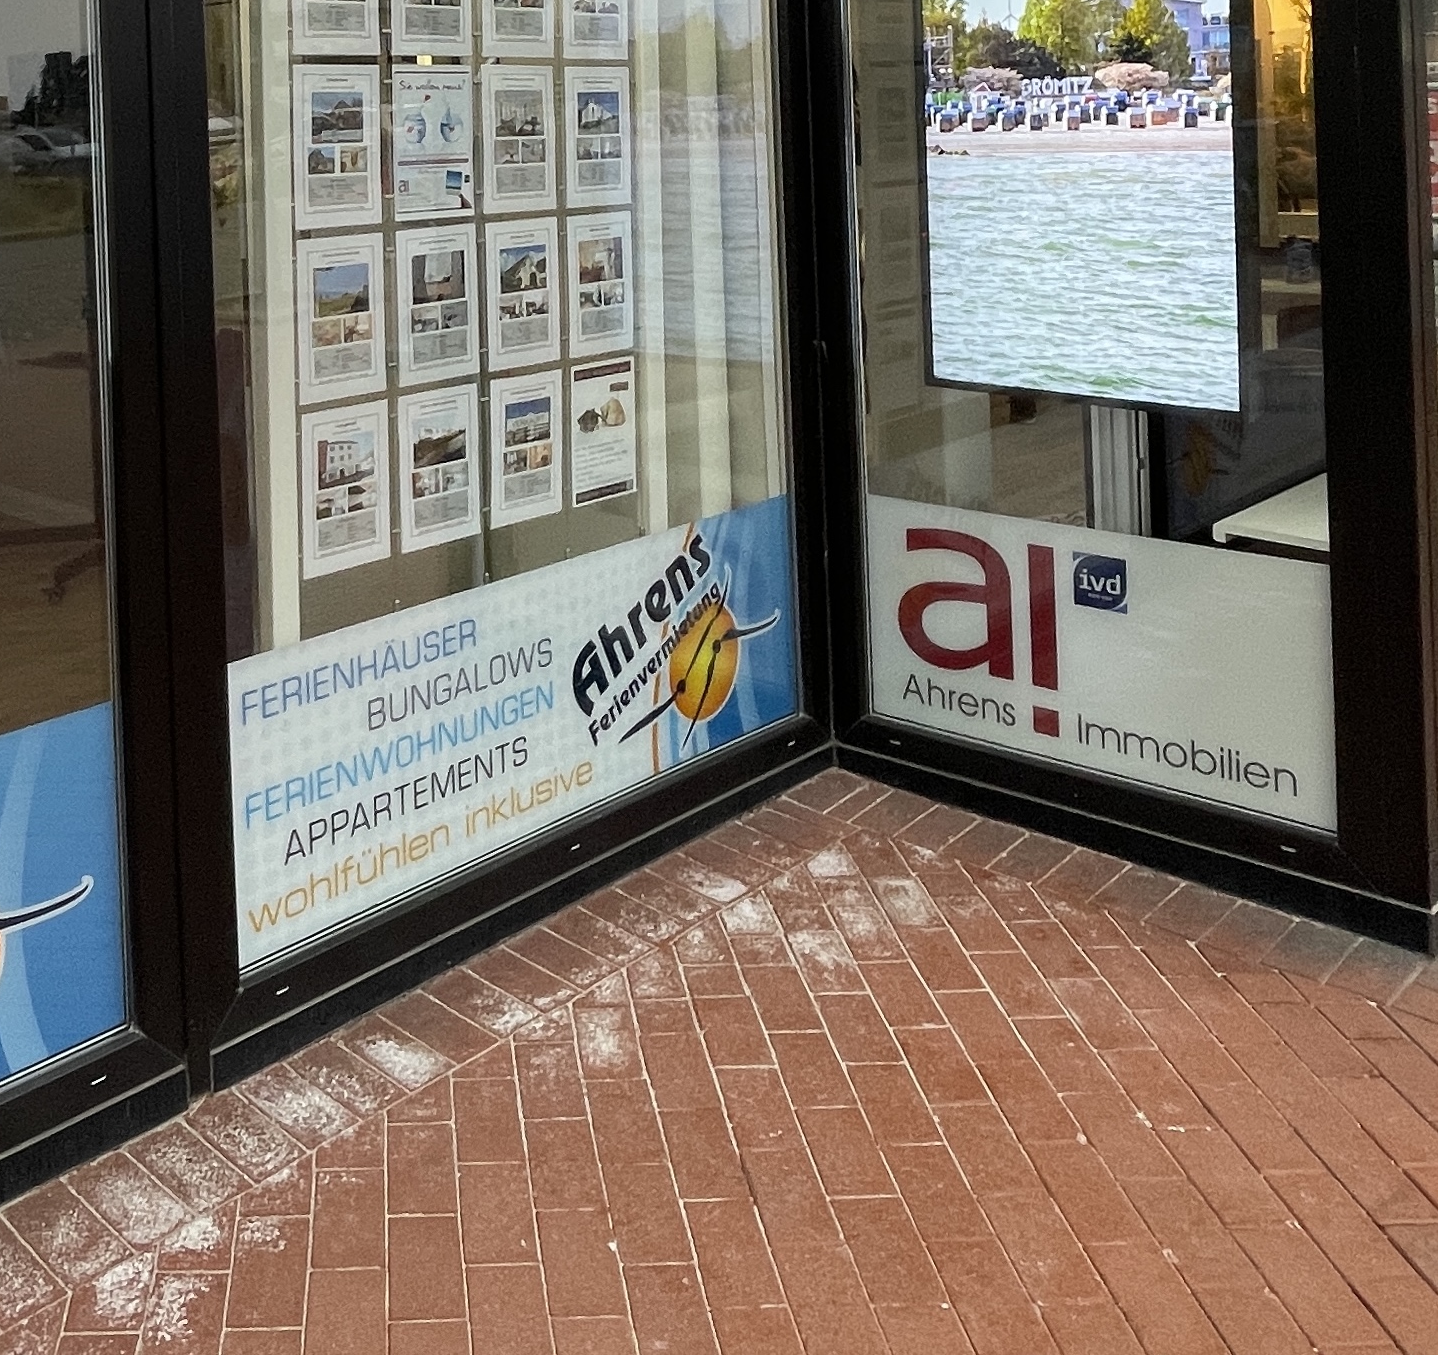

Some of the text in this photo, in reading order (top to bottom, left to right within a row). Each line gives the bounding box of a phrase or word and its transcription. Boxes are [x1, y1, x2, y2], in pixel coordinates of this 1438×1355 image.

[1022, 75, 1094, 96] GRÖMITZ
[572, 534, 711, 717] Ahrens
[1079, 568, 1121, 595] ivd
[240, 618, 477, 727] FERIENHÄUSER
[367, 638, 553, 731] BUNGALOWS
[588, 582, 721, 746] Ferienvermietung
[244, 681, 555, 830] FERIENWOHNUNGEN
[903, 674, 1298, 797] Ahrens Immobilien
[248, 761, 593, 933] wohlfühlen inklusive
[283, 737, 529, 865] APPARTEMENTS
